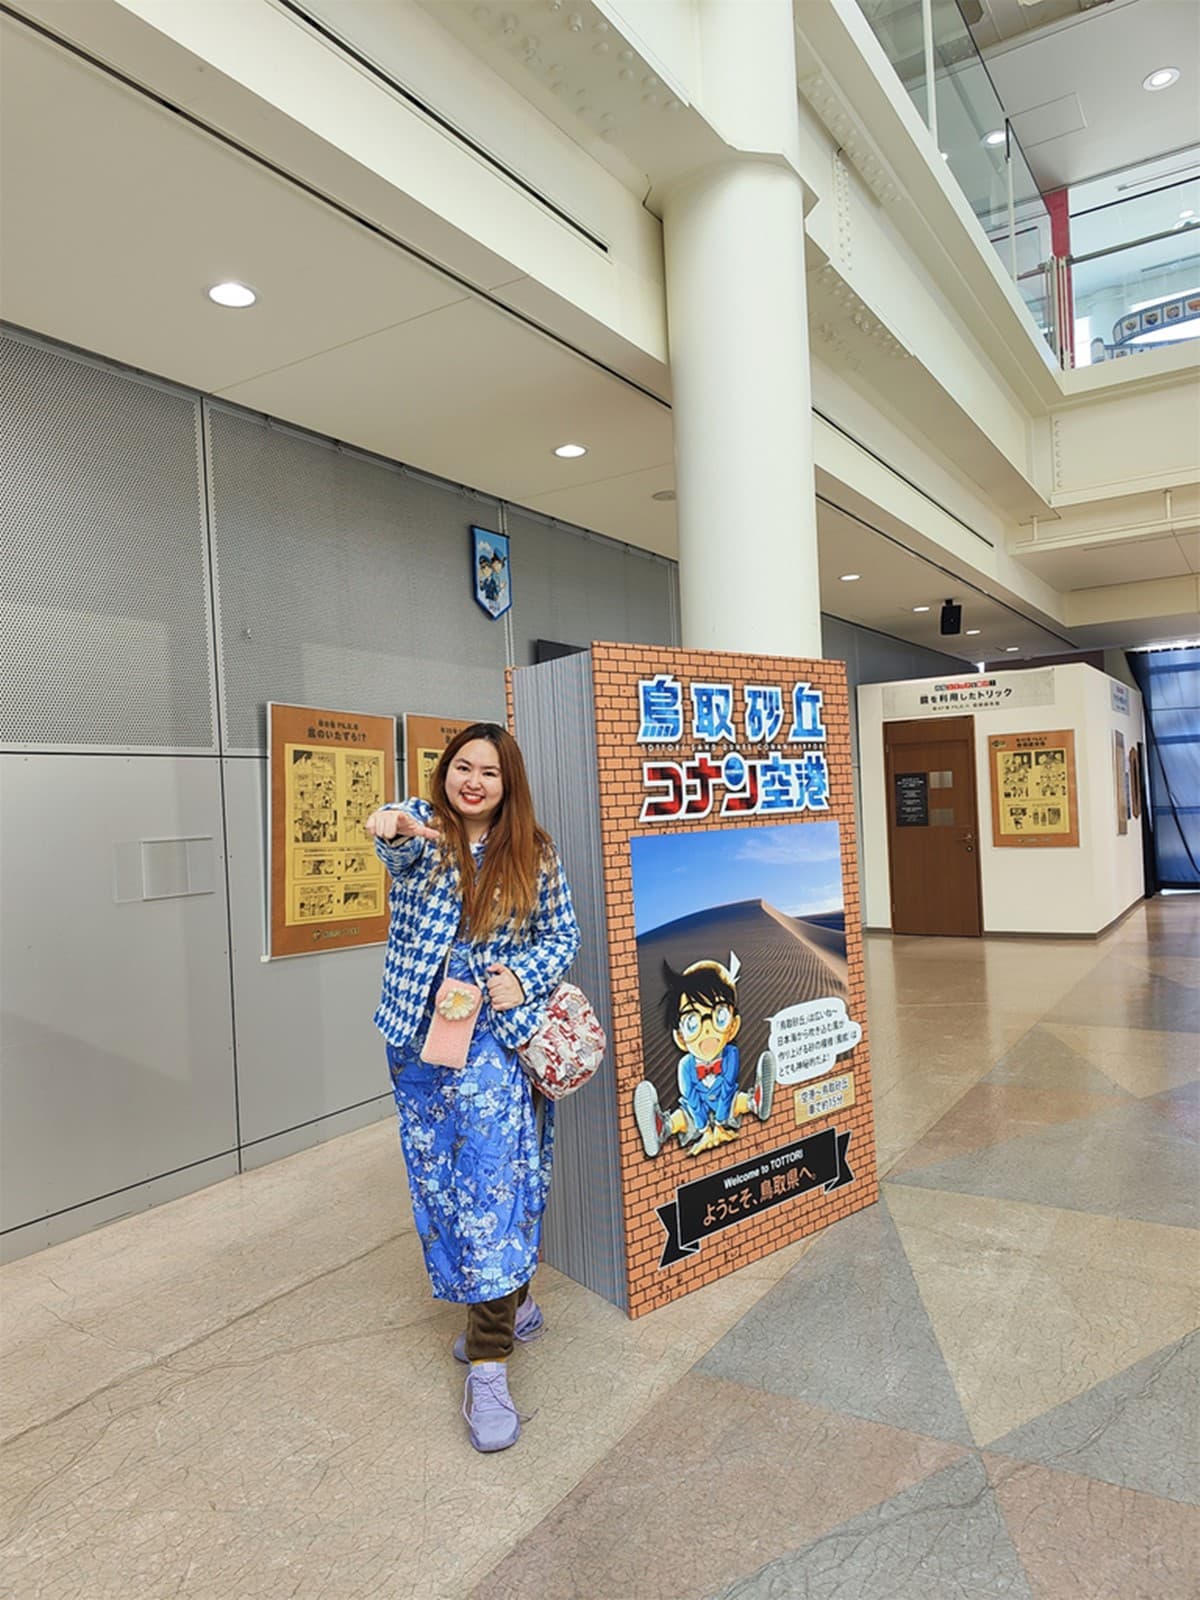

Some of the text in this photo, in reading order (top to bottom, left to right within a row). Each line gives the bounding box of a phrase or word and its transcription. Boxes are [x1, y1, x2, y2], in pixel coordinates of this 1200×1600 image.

[638, 675, 826, 743] 鳥取砂丘
[640, 752, 829, 822] コナン空港
[723, 1149, 804, 1189] Welcome to TOTTORI
